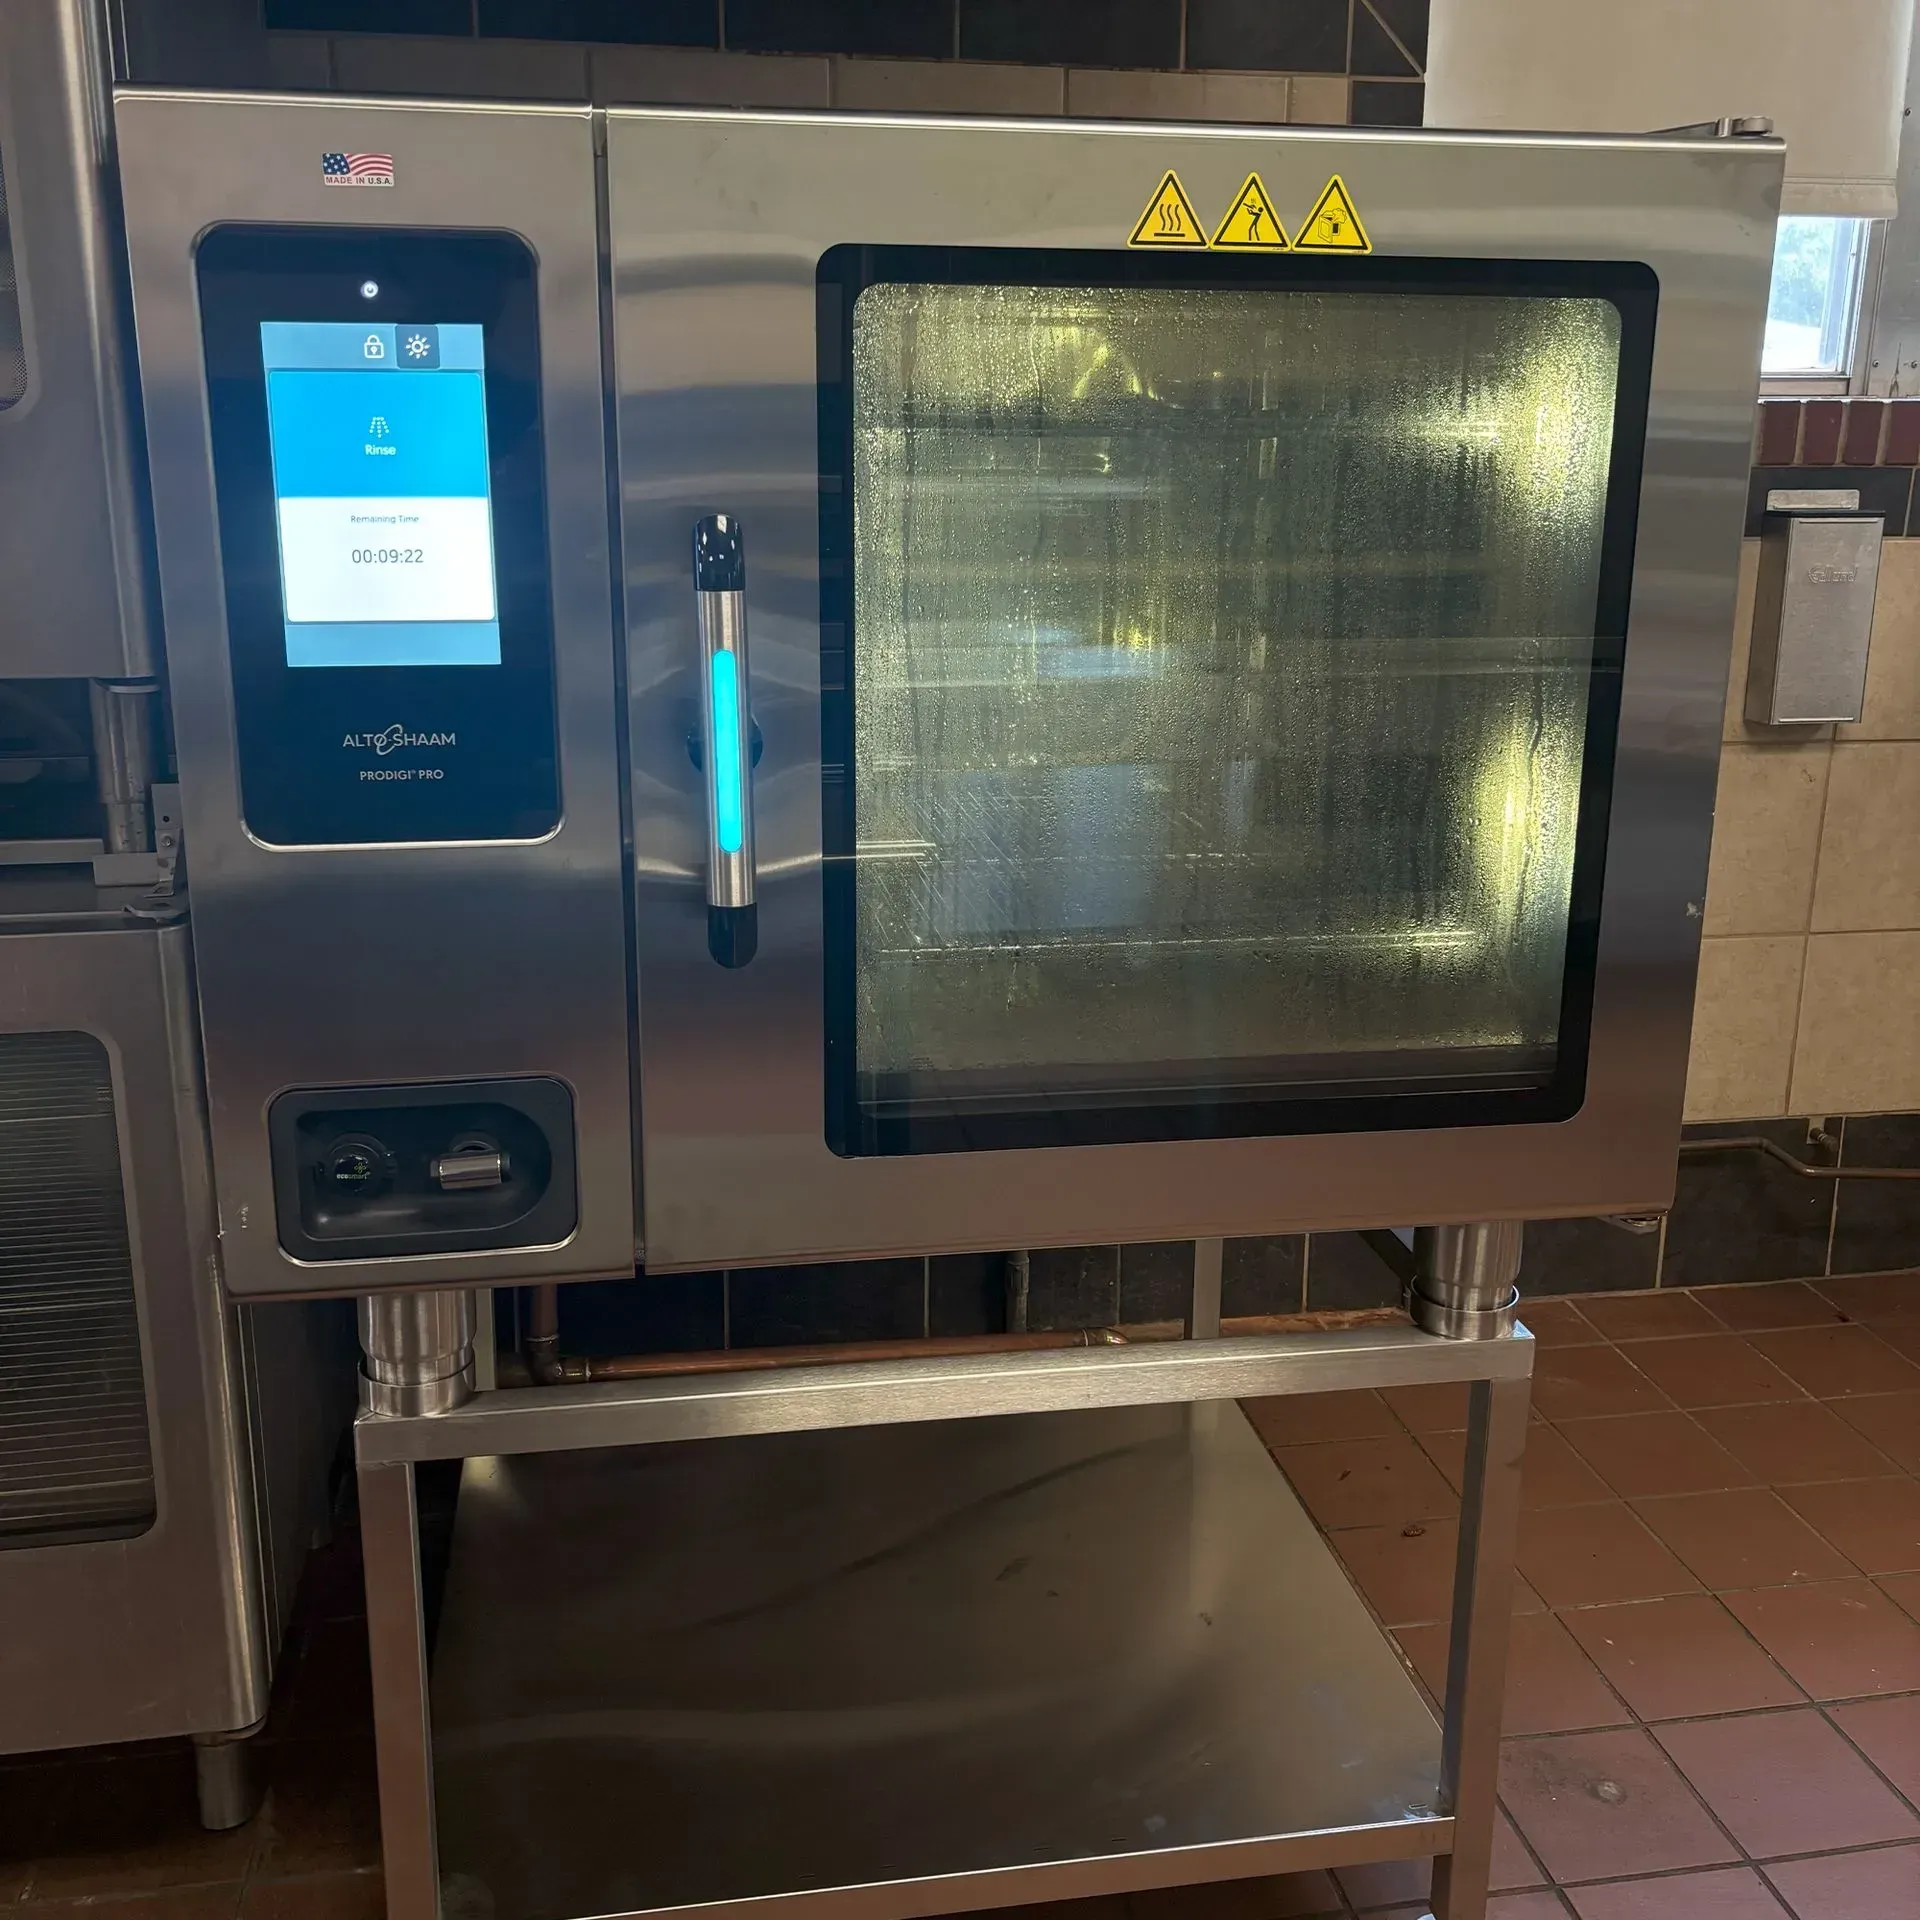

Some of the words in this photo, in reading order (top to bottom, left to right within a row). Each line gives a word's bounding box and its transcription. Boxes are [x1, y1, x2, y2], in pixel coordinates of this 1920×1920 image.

[325, 176, 353, 185] MADE
[355, 177, 365, 185] IN
[367, 177, 393, 186] U.S.A.
[365, 444, 397, 456] Rinse
[350, 515, 397, 524] Remaining
[398, 515, 420, 523] Time
[351, 548, 424, 564] 00:09:22
[418, 769, 444, 779] PRO
